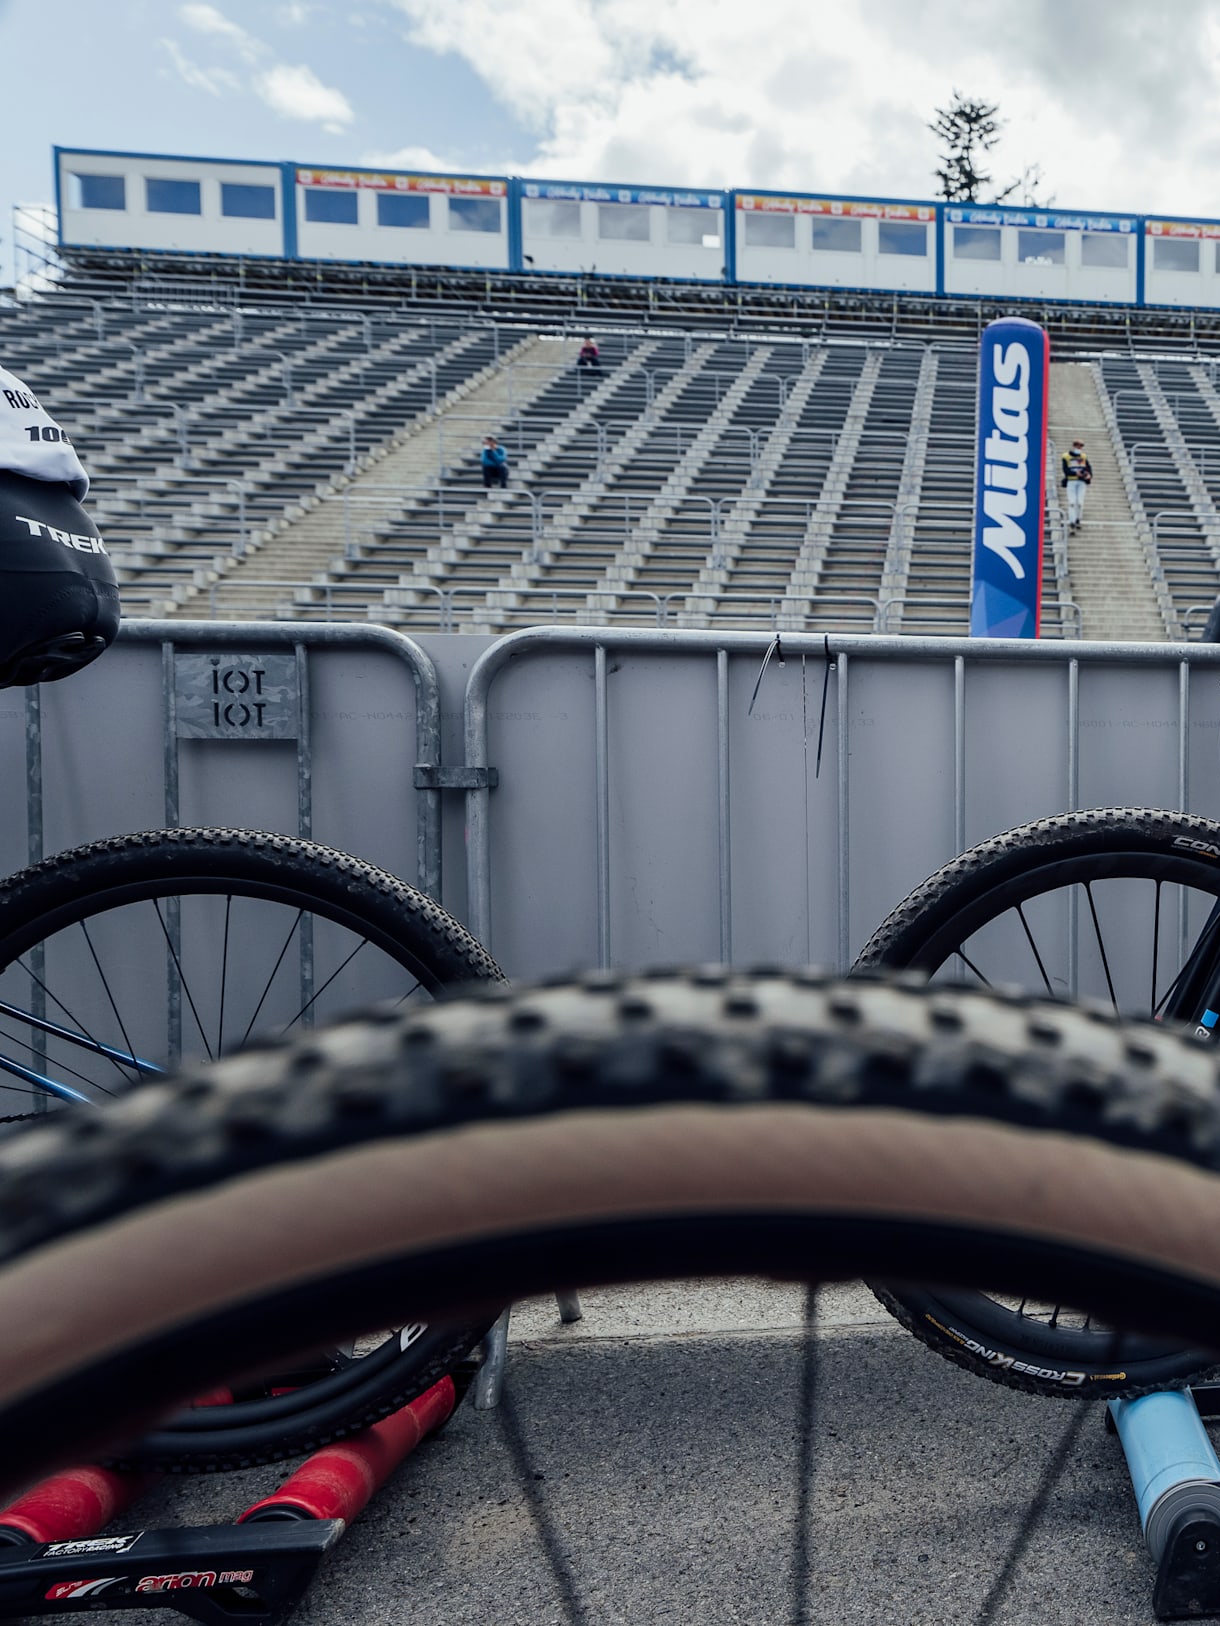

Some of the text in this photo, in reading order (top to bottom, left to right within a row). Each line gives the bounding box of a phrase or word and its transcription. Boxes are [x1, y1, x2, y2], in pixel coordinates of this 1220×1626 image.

[982, 341, 1031, 579] Mitas
[16, 515, 108, 554] TREK
[48, 1535, 134, 1552] TREK
